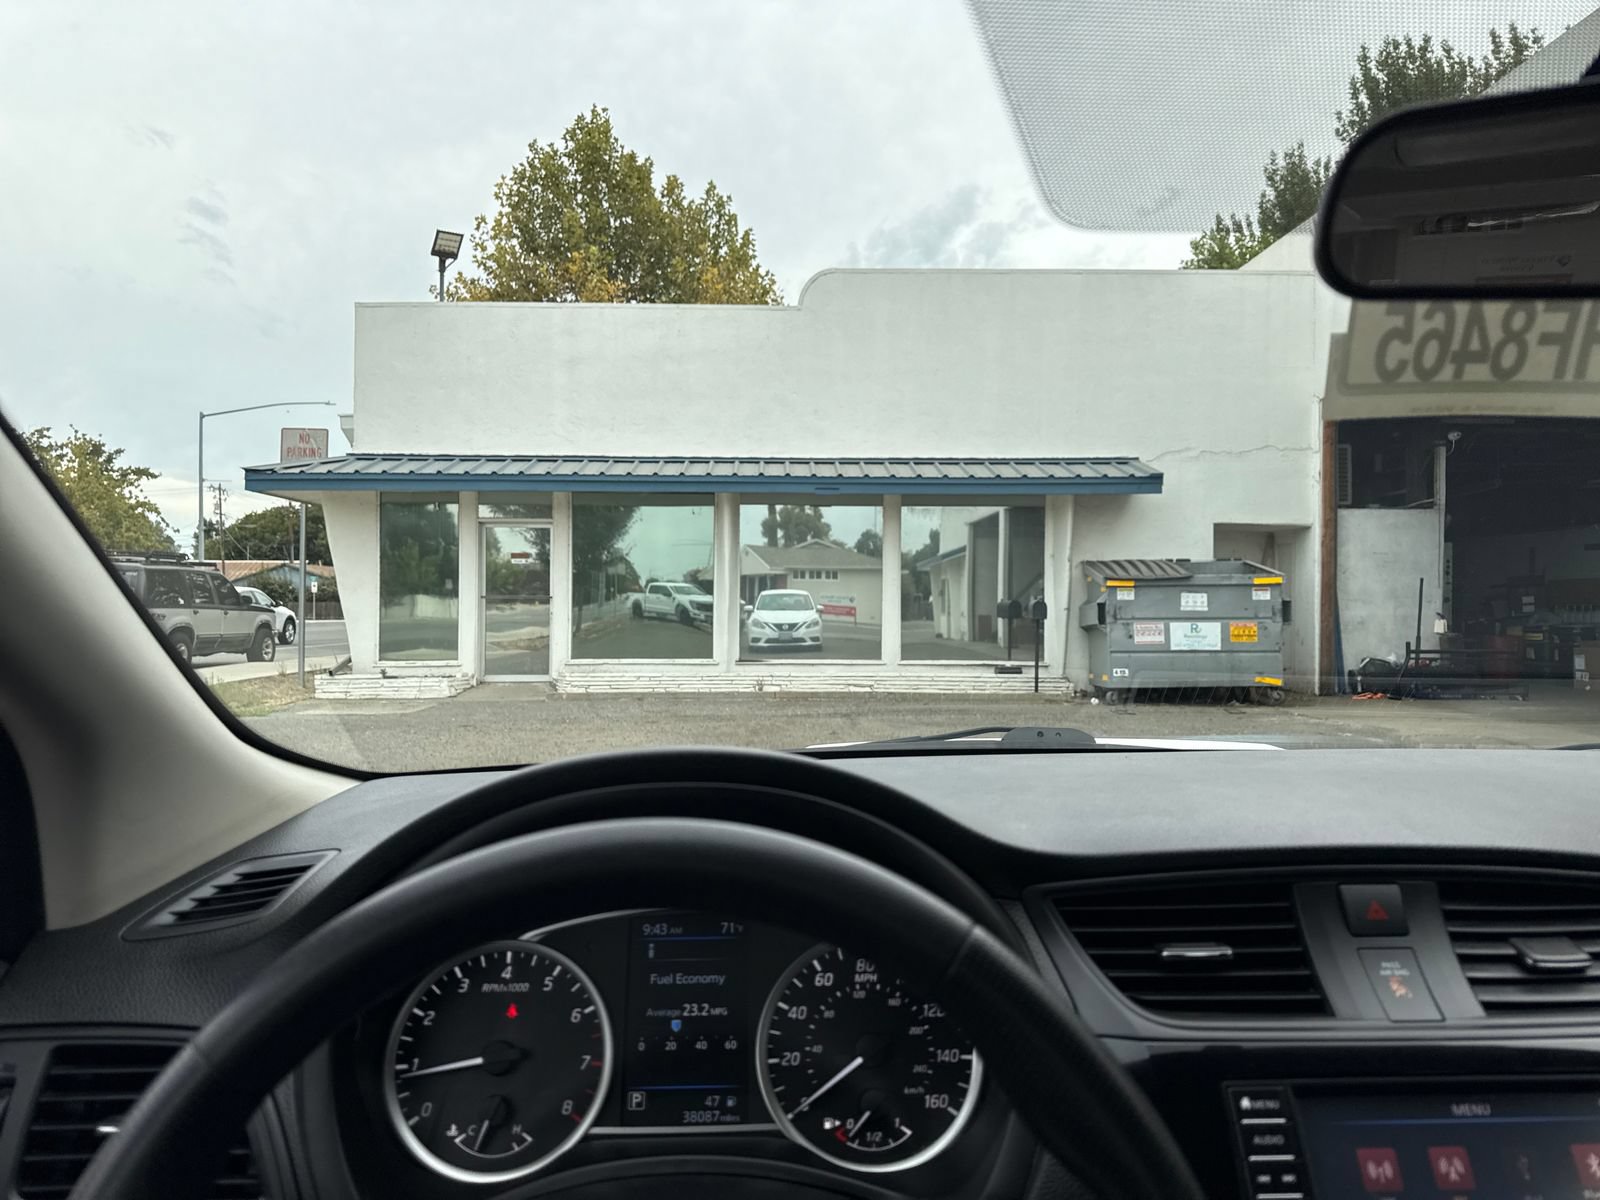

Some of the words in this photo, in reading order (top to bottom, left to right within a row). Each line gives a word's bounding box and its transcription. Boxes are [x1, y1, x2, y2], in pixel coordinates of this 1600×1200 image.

[298, 432, 311, 445] NO
[287, 447, 322, 459] PARKING
[642, 924, 668, 936] 9:43
[501, 966, 513, 979] 4
[854, 973, 878, 983] MPH
[457, 979, 470, 993] 3
[542, 977, 554, 992] 5
[650, 973, 673, 985] Fuel
[676, 973, 726, 986] Economy
[814, 972, 834, 987] 60
[571, 1008, 582, 1023] 6
[646, 1007, 681, 1018] Average
[682, 1003, 709, 1017] 23.2
[710, 1006, 728, 1016] MPG
[788, 1005, 807, 1020] 40
[423, 1011, 435, 1025] 2
[638, 1042, 645, 1051] 0
[665, 1041, 677, 1051] 20
[695, 1041, 708, 1050] 40
[724, 1040, 737, 1050] 60
[580, 1055, 592, 1070] 7
[781, 1052, 800, 1066] 20
[936, 1049, 960, 1063] 140
[411, 1058, 420, 1071] 1
[904, 1085, 925, 1095] km/h
[632, 1093, 642, 1108] P
[704, 1096, 720, 1107] 47
[924, 1094, 949, 1109] 160
[421, 1102, 432, 1117] 0
[561, 1100, 573, 1115] 8
[1451, 1104, 1492, 1117] MENU
[682, 1110, 720, 1123] 38087
[894, 1118, 900, 1128] 1
[467, 1125, 478, 1136] C
[512, 1124, 523, 1135] H
[846, 1119, 855, 1130] 0
[866, 1131, 883, 1142] 1/2
